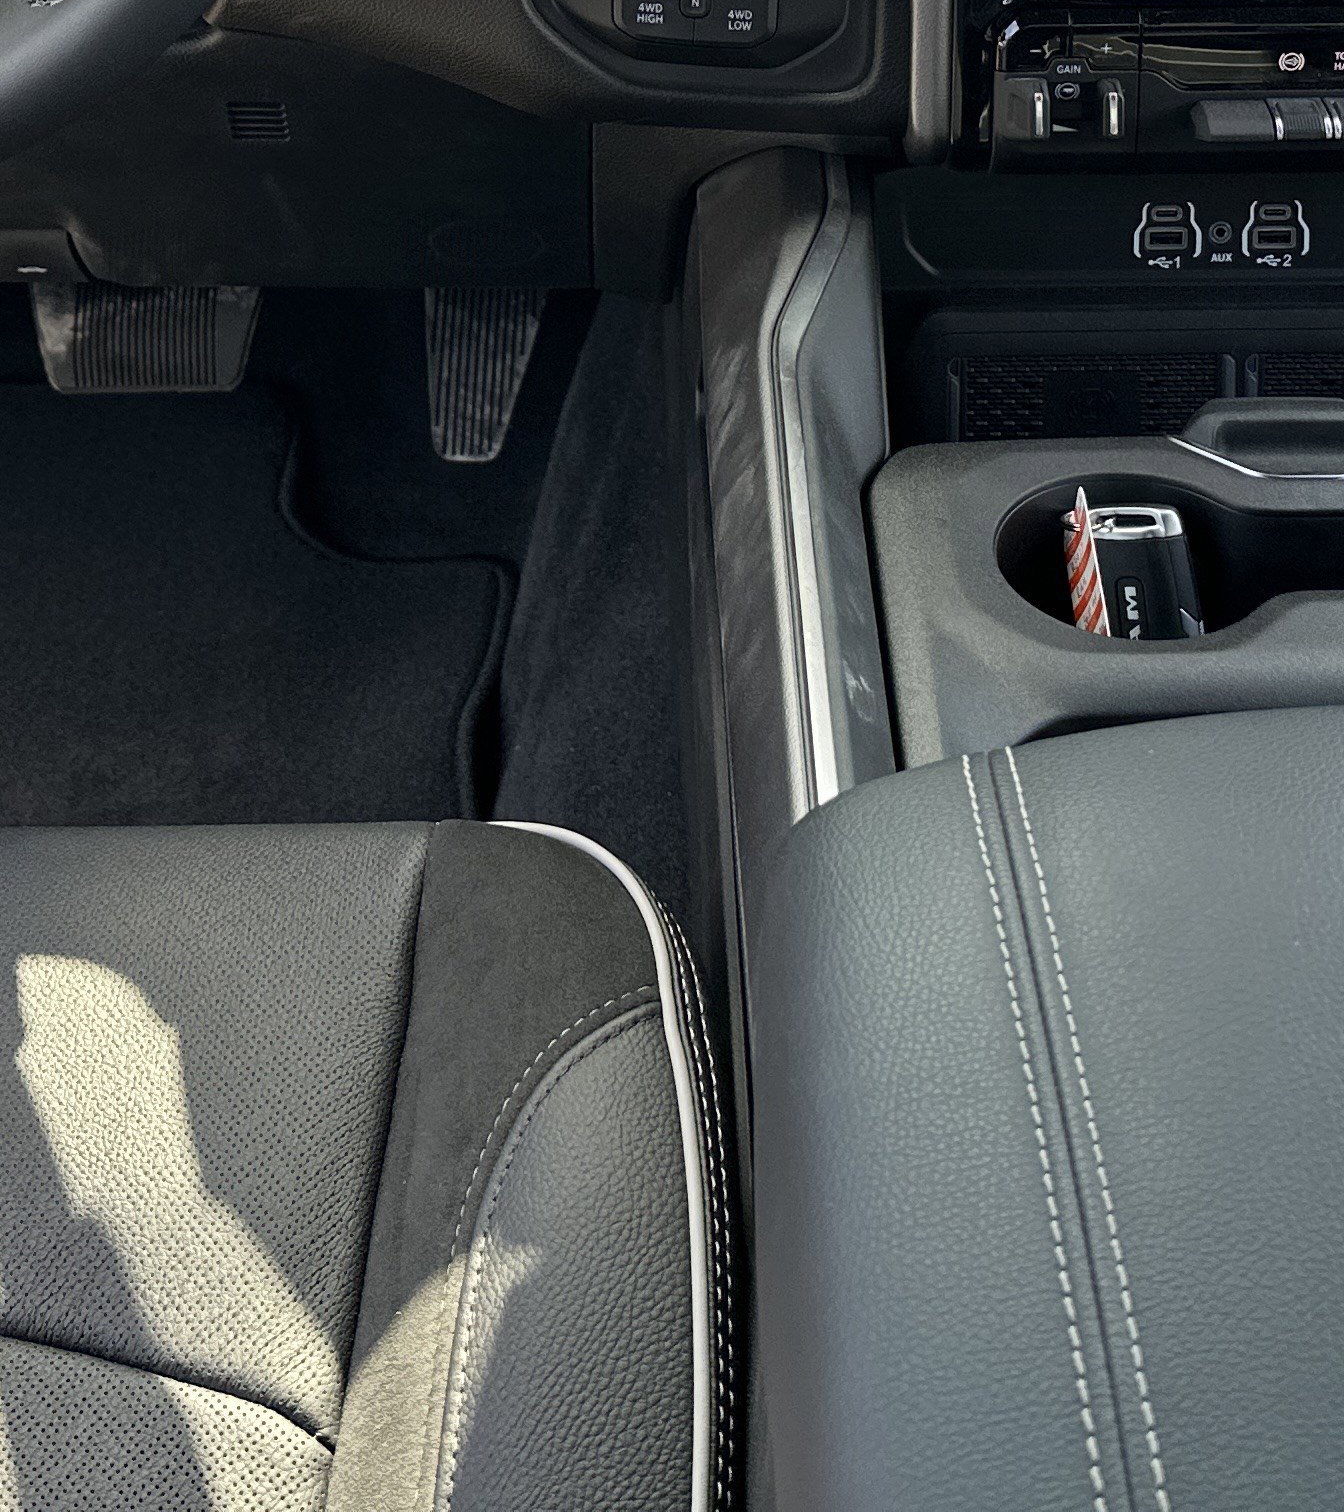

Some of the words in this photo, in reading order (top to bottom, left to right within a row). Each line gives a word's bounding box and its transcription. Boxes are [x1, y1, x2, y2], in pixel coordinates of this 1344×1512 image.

[638, 2, 663, 13] 4WD
[636, 13, 664, 25] HIGH
[727, 9, 753, 20] 4WD
[728, 20, 753, 31] LOW
[1056, 64, 1081, 75] GAIN
[1211, 252, 1233, 263] AUX
